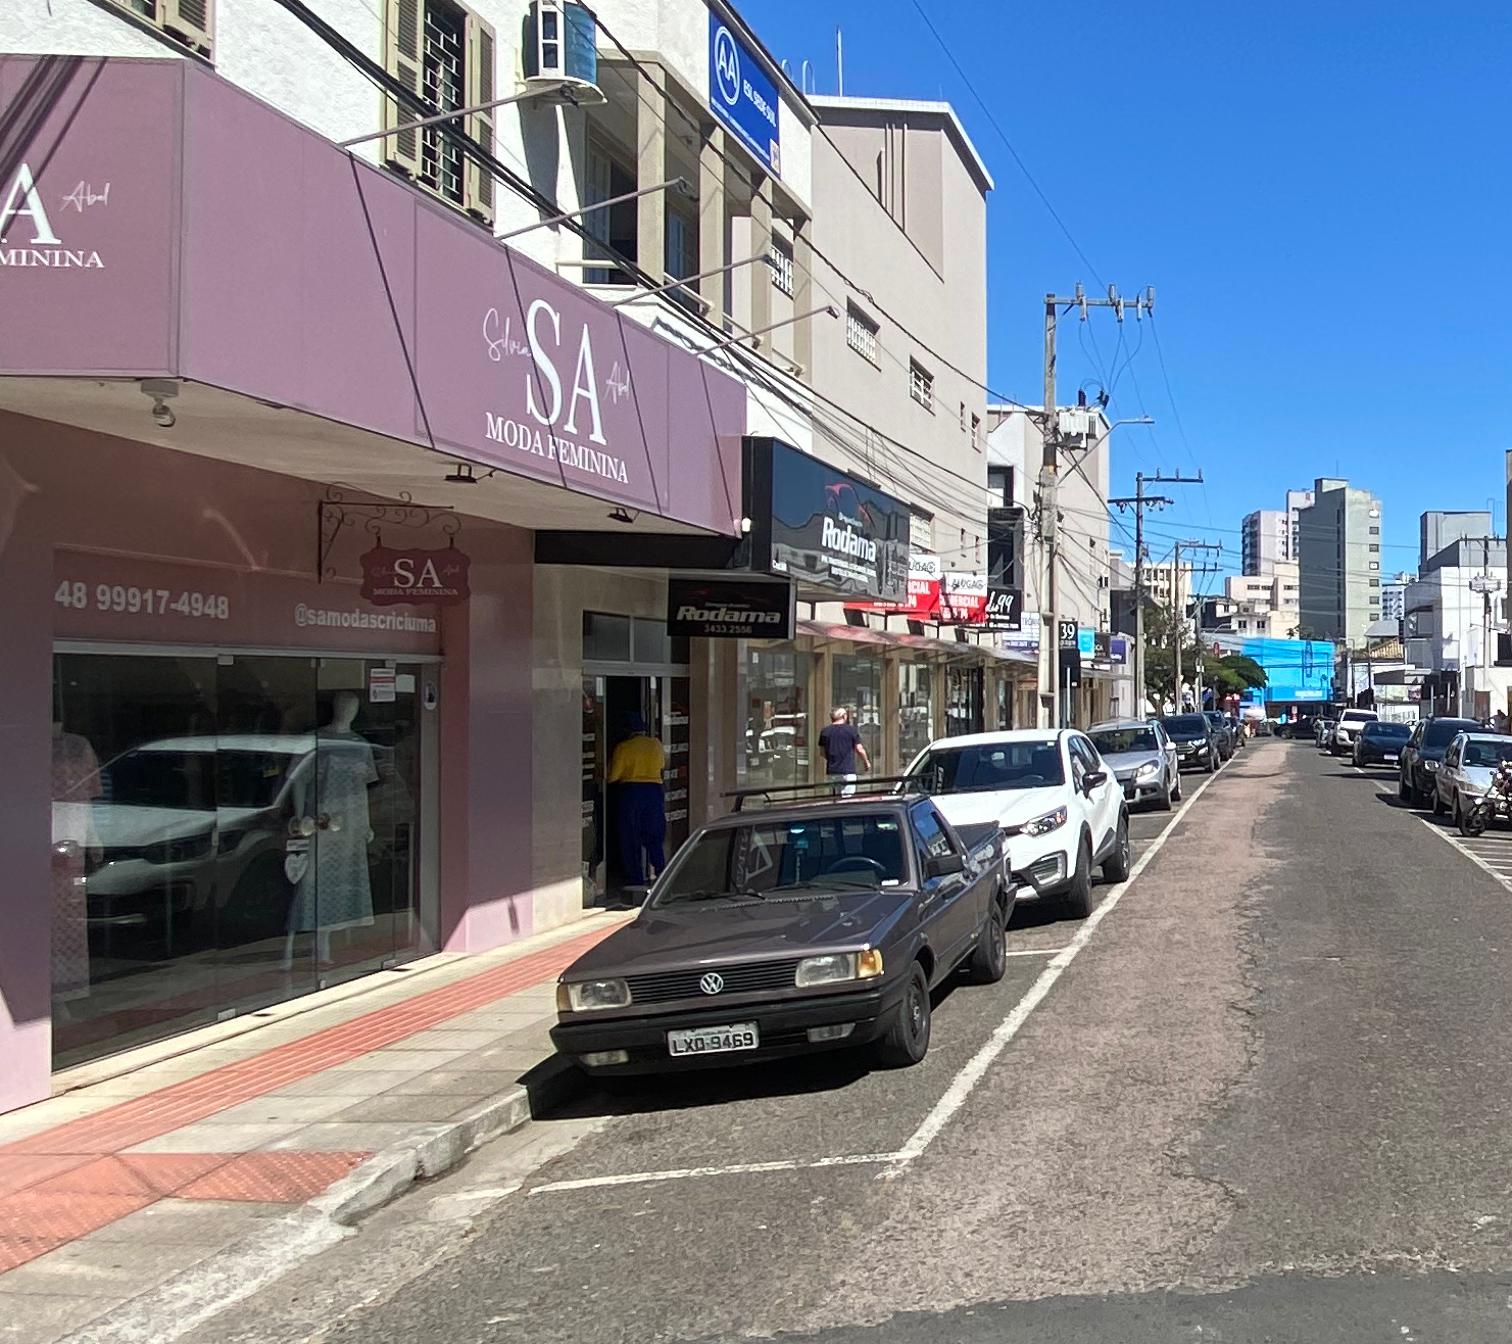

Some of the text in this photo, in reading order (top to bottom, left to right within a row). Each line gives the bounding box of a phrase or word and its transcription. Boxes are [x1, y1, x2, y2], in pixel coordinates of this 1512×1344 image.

[526, 298, 607, 446] SA
[485, 411, 629, 485] MODA FEMININA
[822, 515, 877, 563] Rodama
[393, 557, 443, 588] SA
[54, 579, 230, 620] 48 99917-4948
[676, 605, 782, 624] Rodama
[294, 603, 437, 633] @samodascriciuma
[1060, 623, 1076, 640] 39
